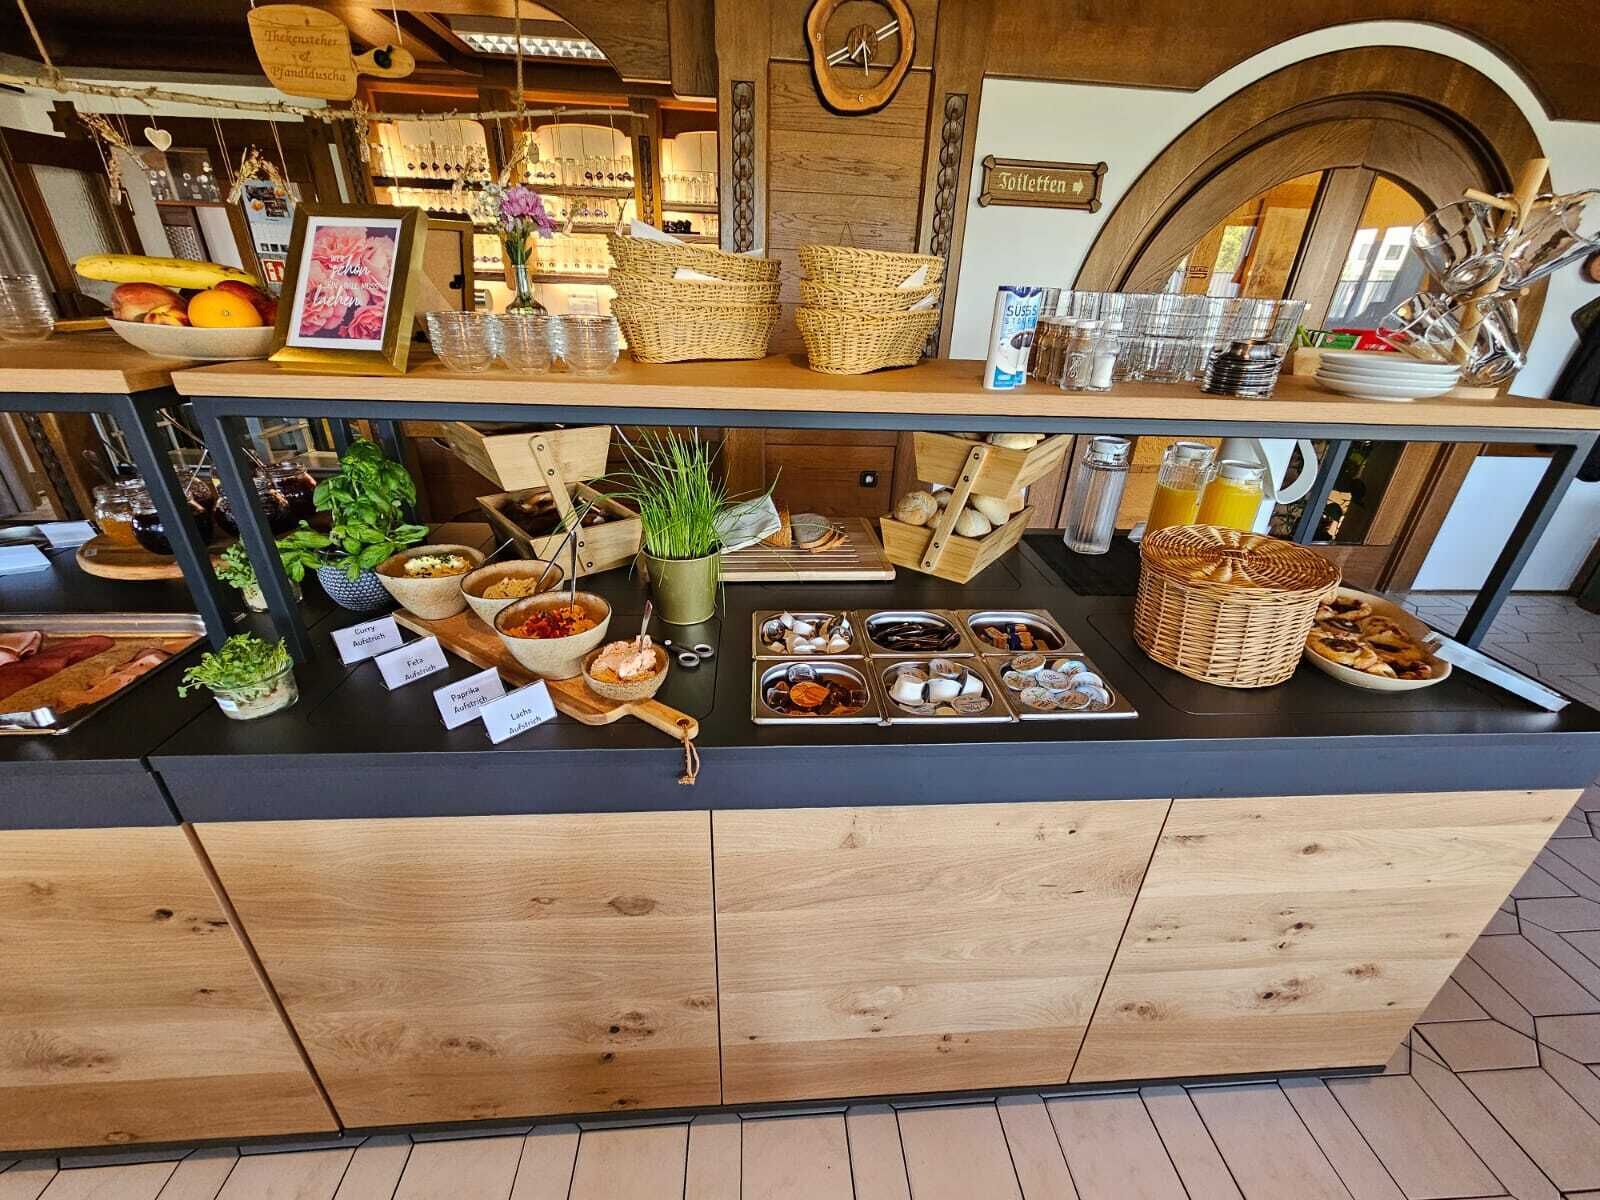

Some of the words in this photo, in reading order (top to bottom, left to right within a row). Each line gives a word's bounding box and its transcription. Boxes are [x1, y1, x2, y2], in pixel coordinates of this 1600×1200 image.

[998, 171, 1067, 193] Toiletten
[354, 624, 375, 635] Curry
[352, 632, 386, 647] Aufstrich
[406, 657, 425, 668] Feta
[404, 664, 436, 680] Aufstrich
[450, 686, 480, 702] Paprika
[454, 695, 488, 714] Aufstrich
[510, 708, 532, 721] Lachs
[509, 716, 542, 735] Aufstrich
